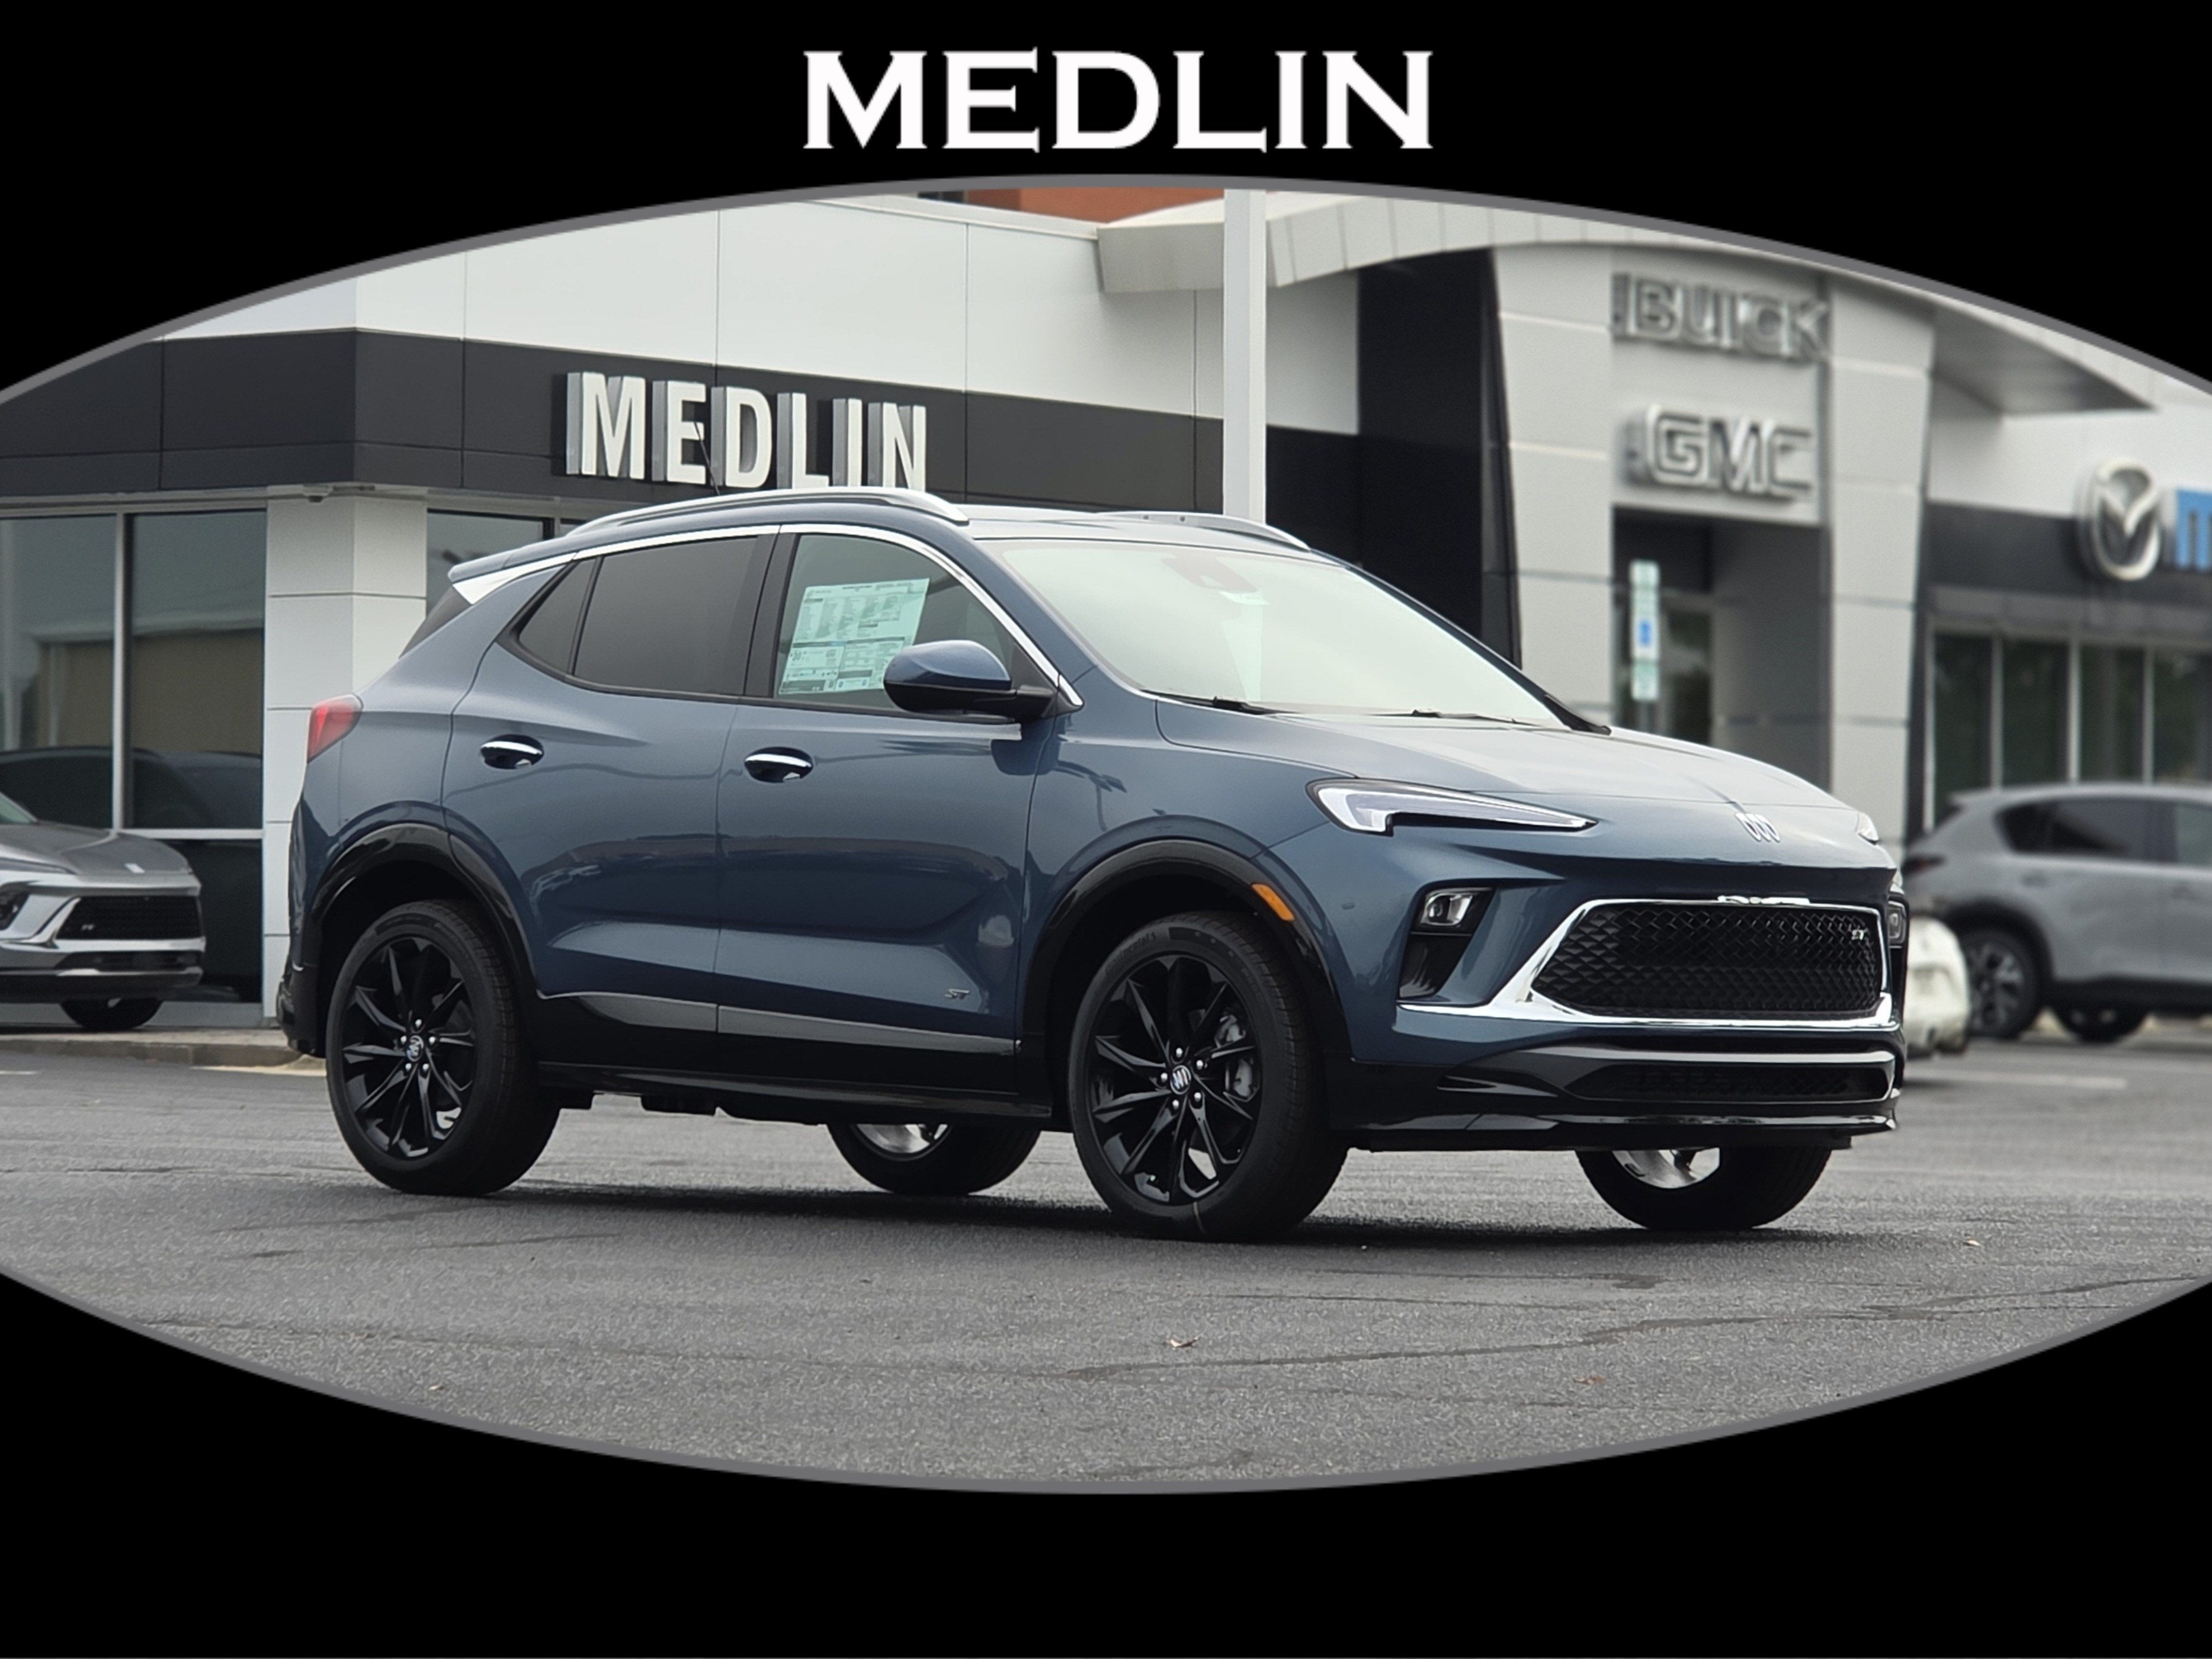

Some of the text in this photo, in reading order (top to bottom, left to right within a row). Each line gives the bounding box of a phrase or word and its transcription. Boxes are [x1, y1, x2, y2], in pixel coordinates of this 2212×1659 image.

[1614, 273, 1829, 362] BUICK
[567, 371, 927, 493] MEDLIN
[1635, 405, 1813, 498] GMC
